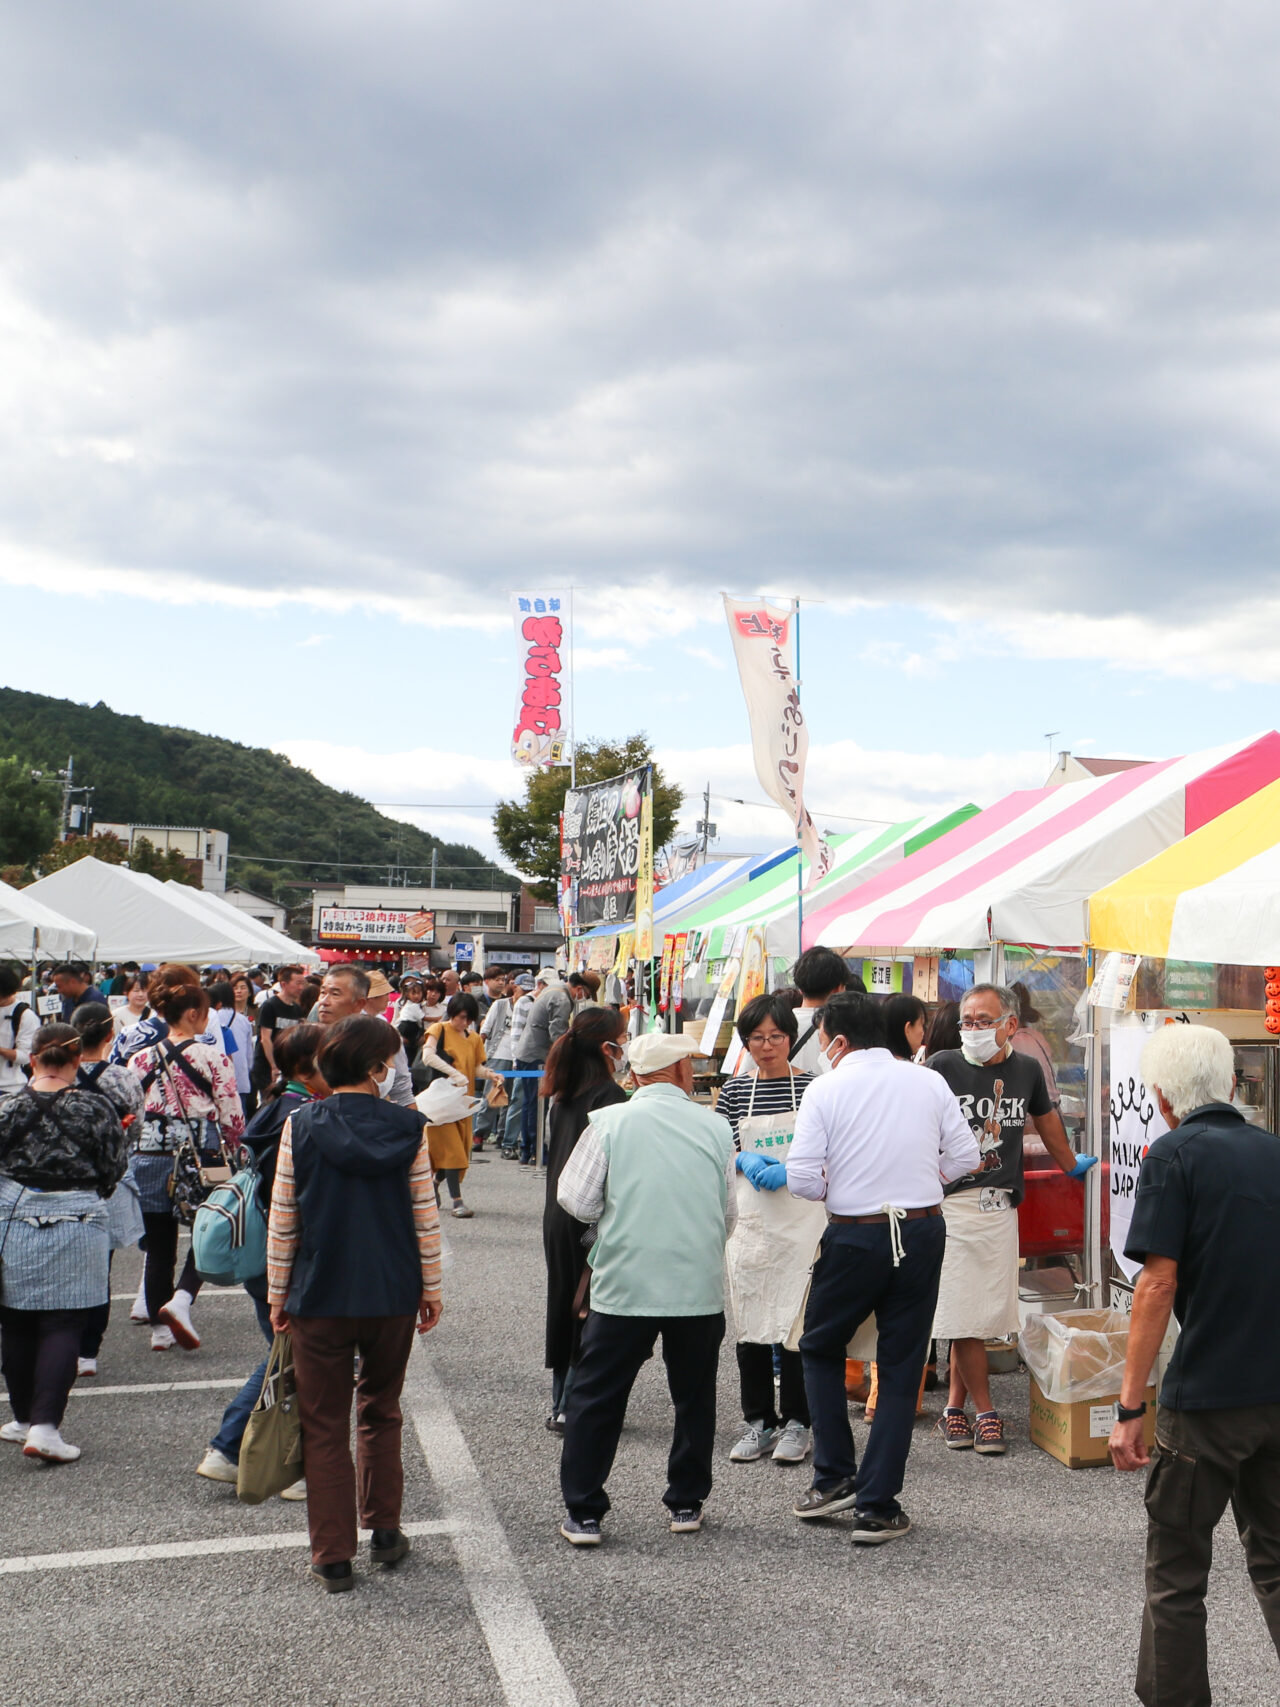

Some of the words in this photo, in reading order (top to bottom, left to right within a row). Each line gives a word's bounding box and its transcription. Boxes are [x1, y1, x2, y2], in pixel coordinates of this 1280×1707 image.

[957, 1094, 1025, 1120] ROCK
[1002, 1119, 1025, 1127] MUSIC
[1112, 1141, 1141, 1168] MILK
